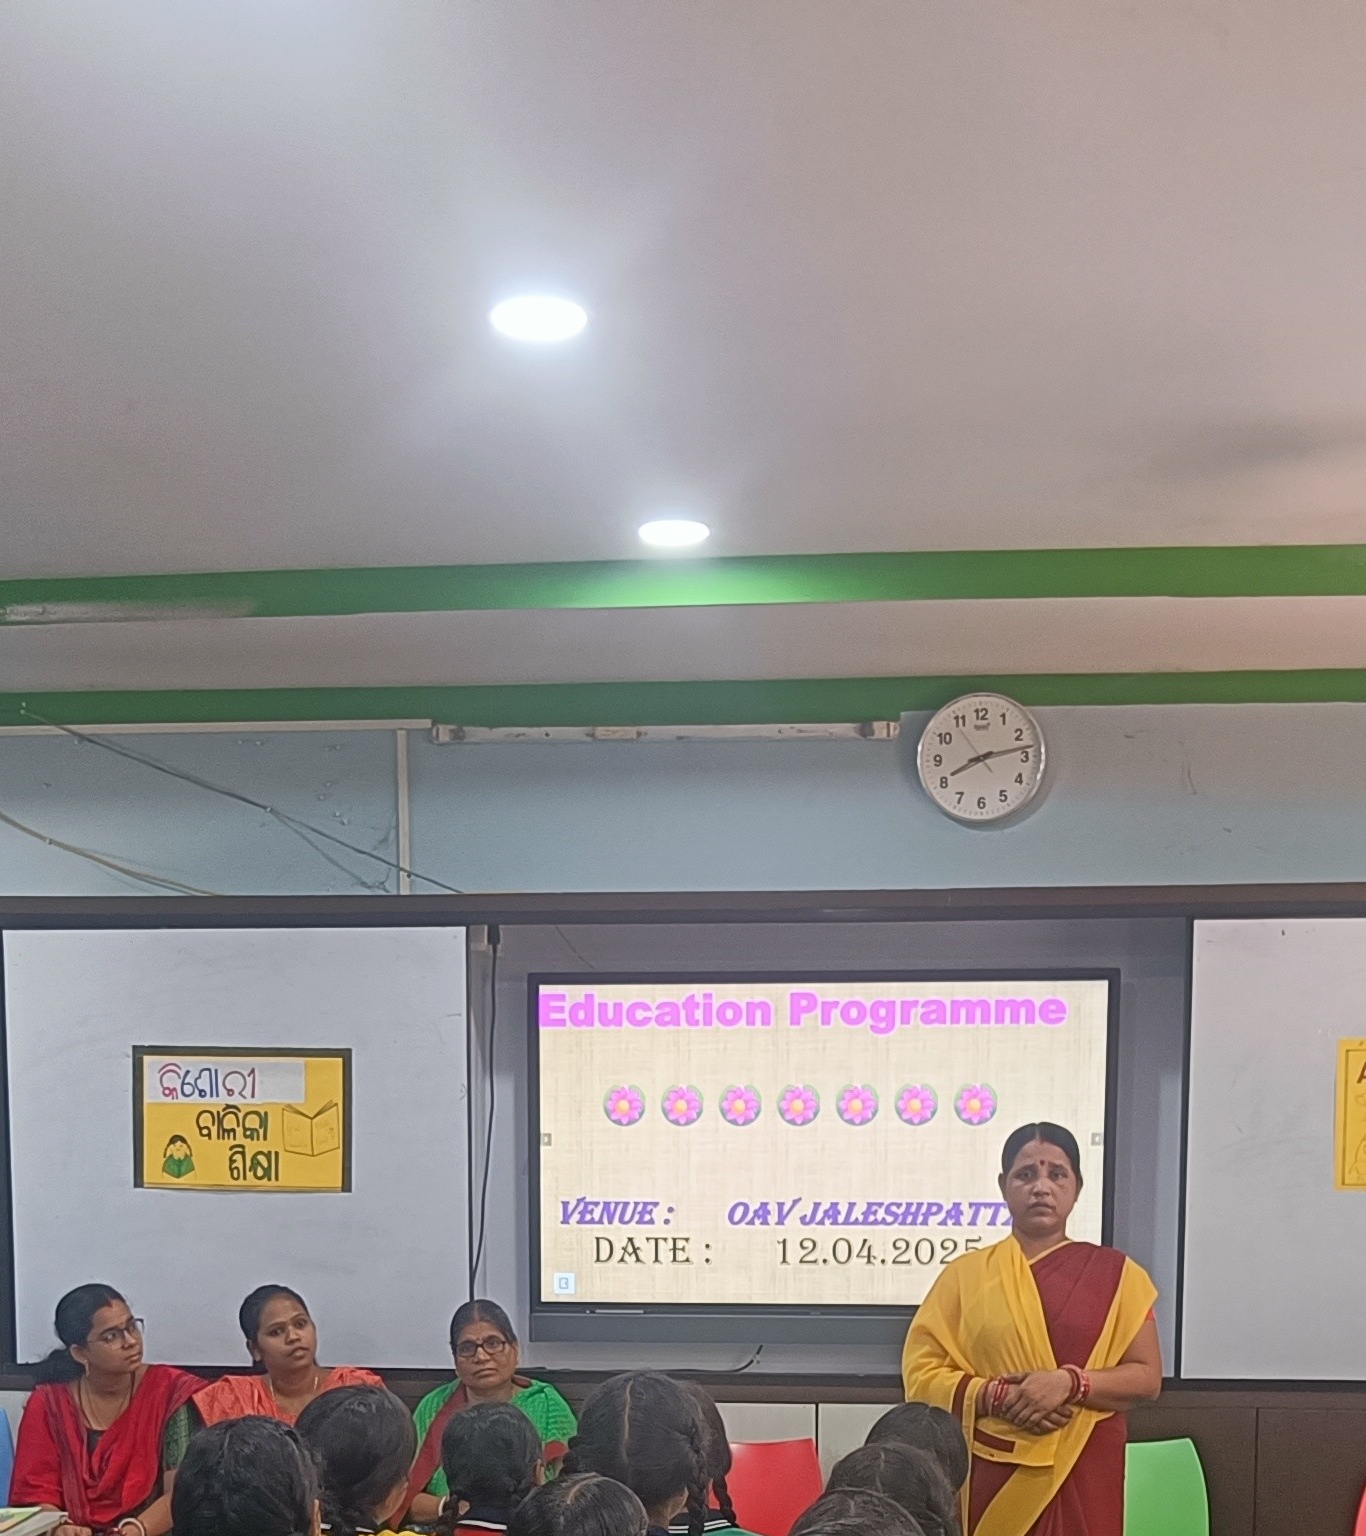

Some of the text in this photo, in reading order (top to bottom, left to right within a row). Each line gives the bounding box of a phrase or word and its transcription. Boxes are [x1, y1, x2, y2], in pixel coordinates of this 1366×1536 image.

[974, 707, 989, 721] 12
[999, 712, 1007, 726] 1
[953, 714, 966, 728] 11
[937, 732, 952, 745] 10
[1014, 728, 1024, 742] 2
[933, 754, 942, 767] 9
[1020, 750, 1029, 763] 3
[939, 776, 948, 789] 8
[1014, 772, 1023, 786] 4
[955, 791, 964, 804] 7
[999, 789, 1008, 802] 5
[977, 796, 986, 809] 6
[538, 991, 1067, 1035] Education Programme
[727, 1197, 802, 1226] OAV
